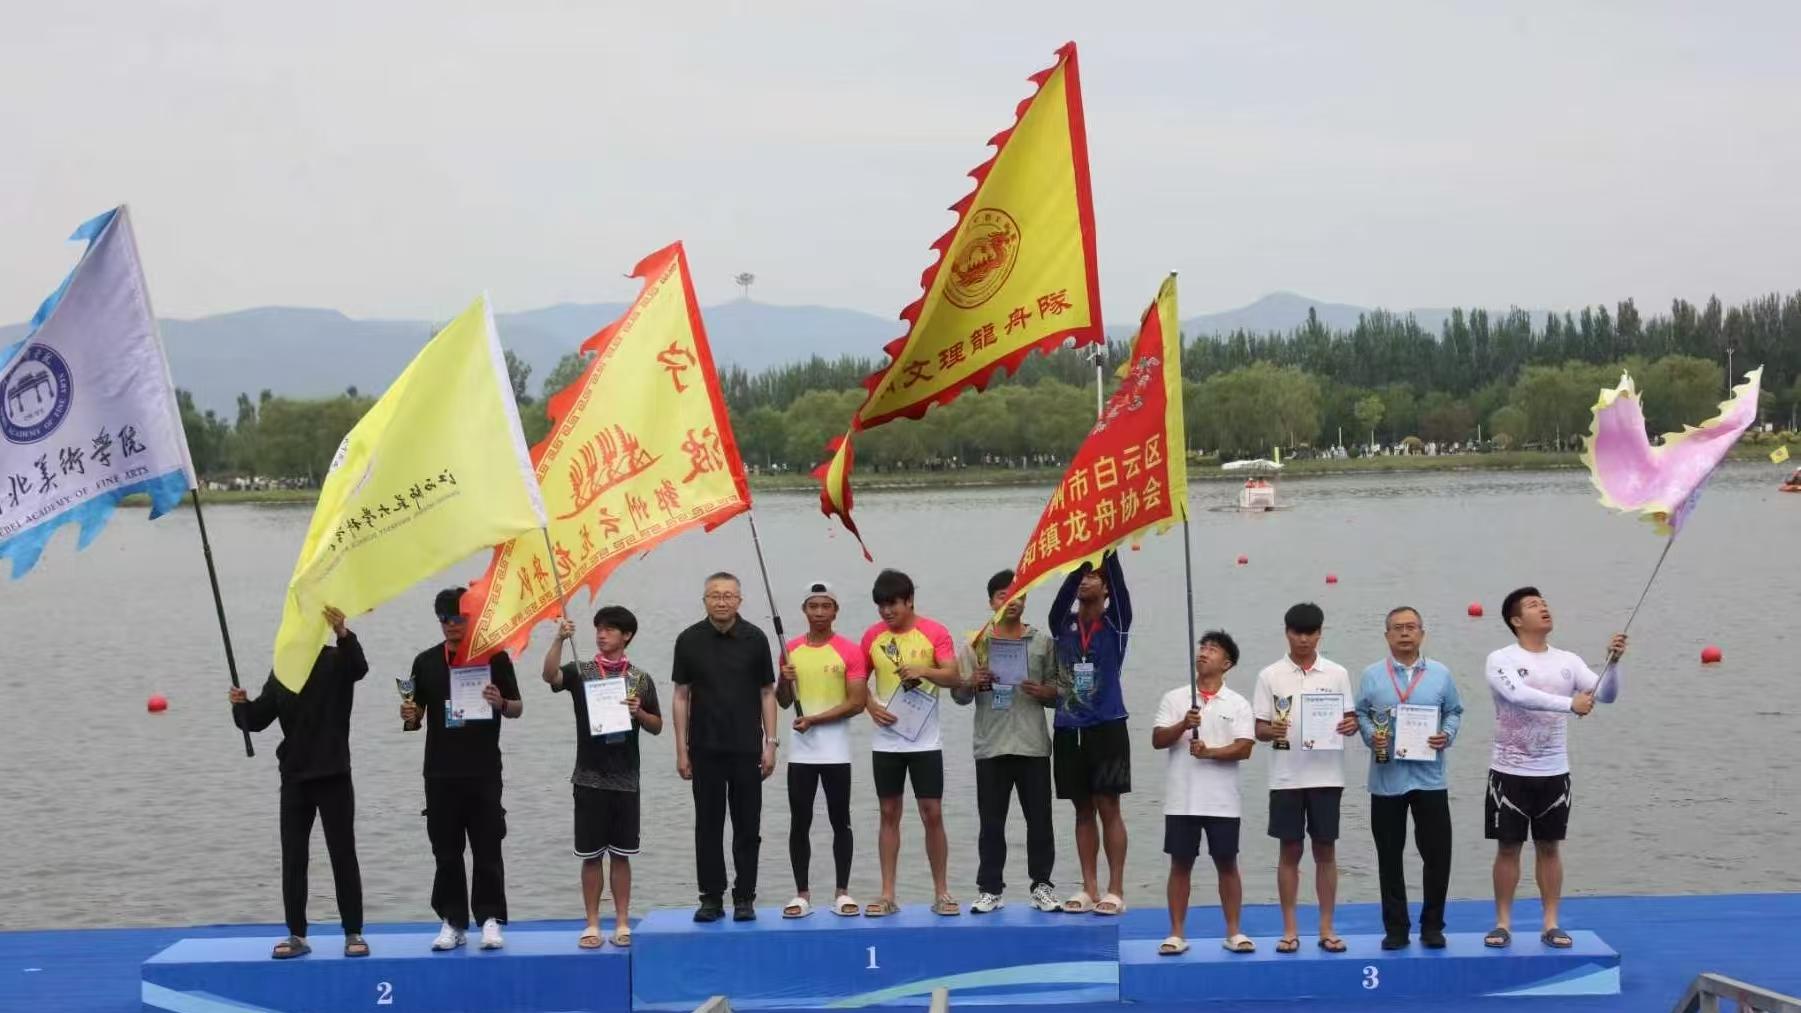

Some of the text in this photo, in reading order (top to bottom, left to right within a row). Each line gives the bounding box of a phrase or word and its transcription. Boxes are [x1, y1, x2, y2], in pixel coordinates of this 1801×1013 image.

[0, 424, 147, 515] 北美術學院
[25, 495, 71, 524] ACADEMY
[75, 486, 89, 499] OF
[95, 474, 120, 490] FINE
[125, 465, 150, 481] ARTS
[1013, 476, 1162, 582] 和镇龙舟协会
[865, 946, 881, 969] 1
[1362, 965, 1379, 989] 3
[376, 981, 393, 1005] 2
